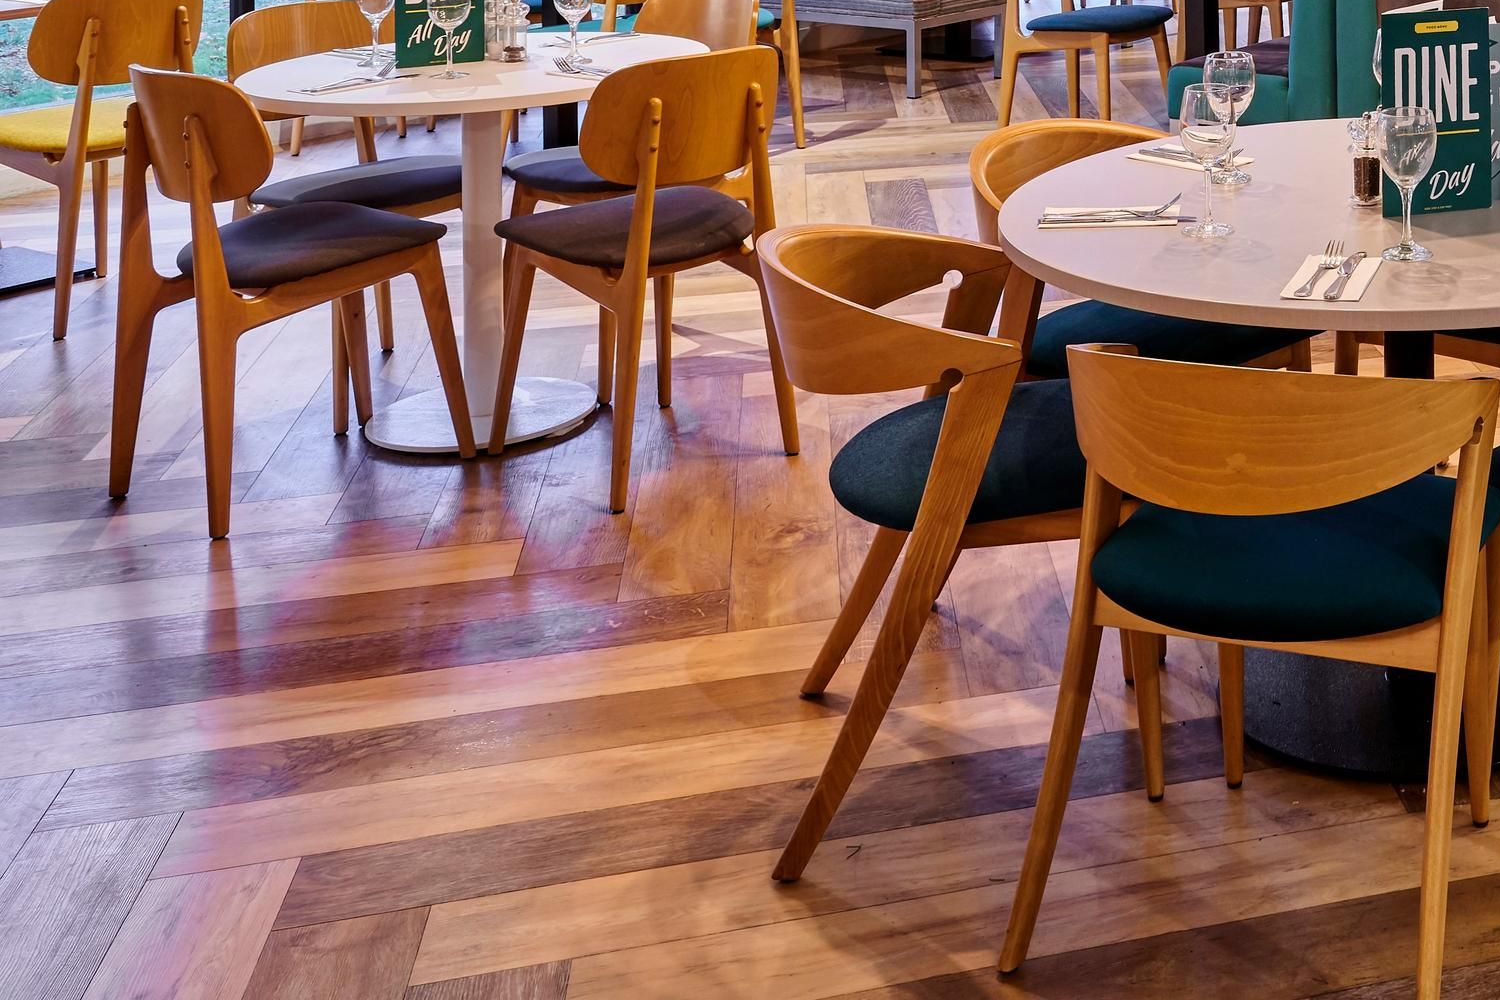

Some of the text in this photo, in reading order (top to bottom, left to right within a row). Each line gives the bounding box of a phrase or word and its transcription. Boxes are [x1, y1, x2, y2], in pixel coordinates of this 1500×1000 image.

[407, 18, 434, 48] All
[433, 29, 472, 57] Day
[1394, 42, 1480, 126] DINE
[1429, 162, 1475, 200] Day
